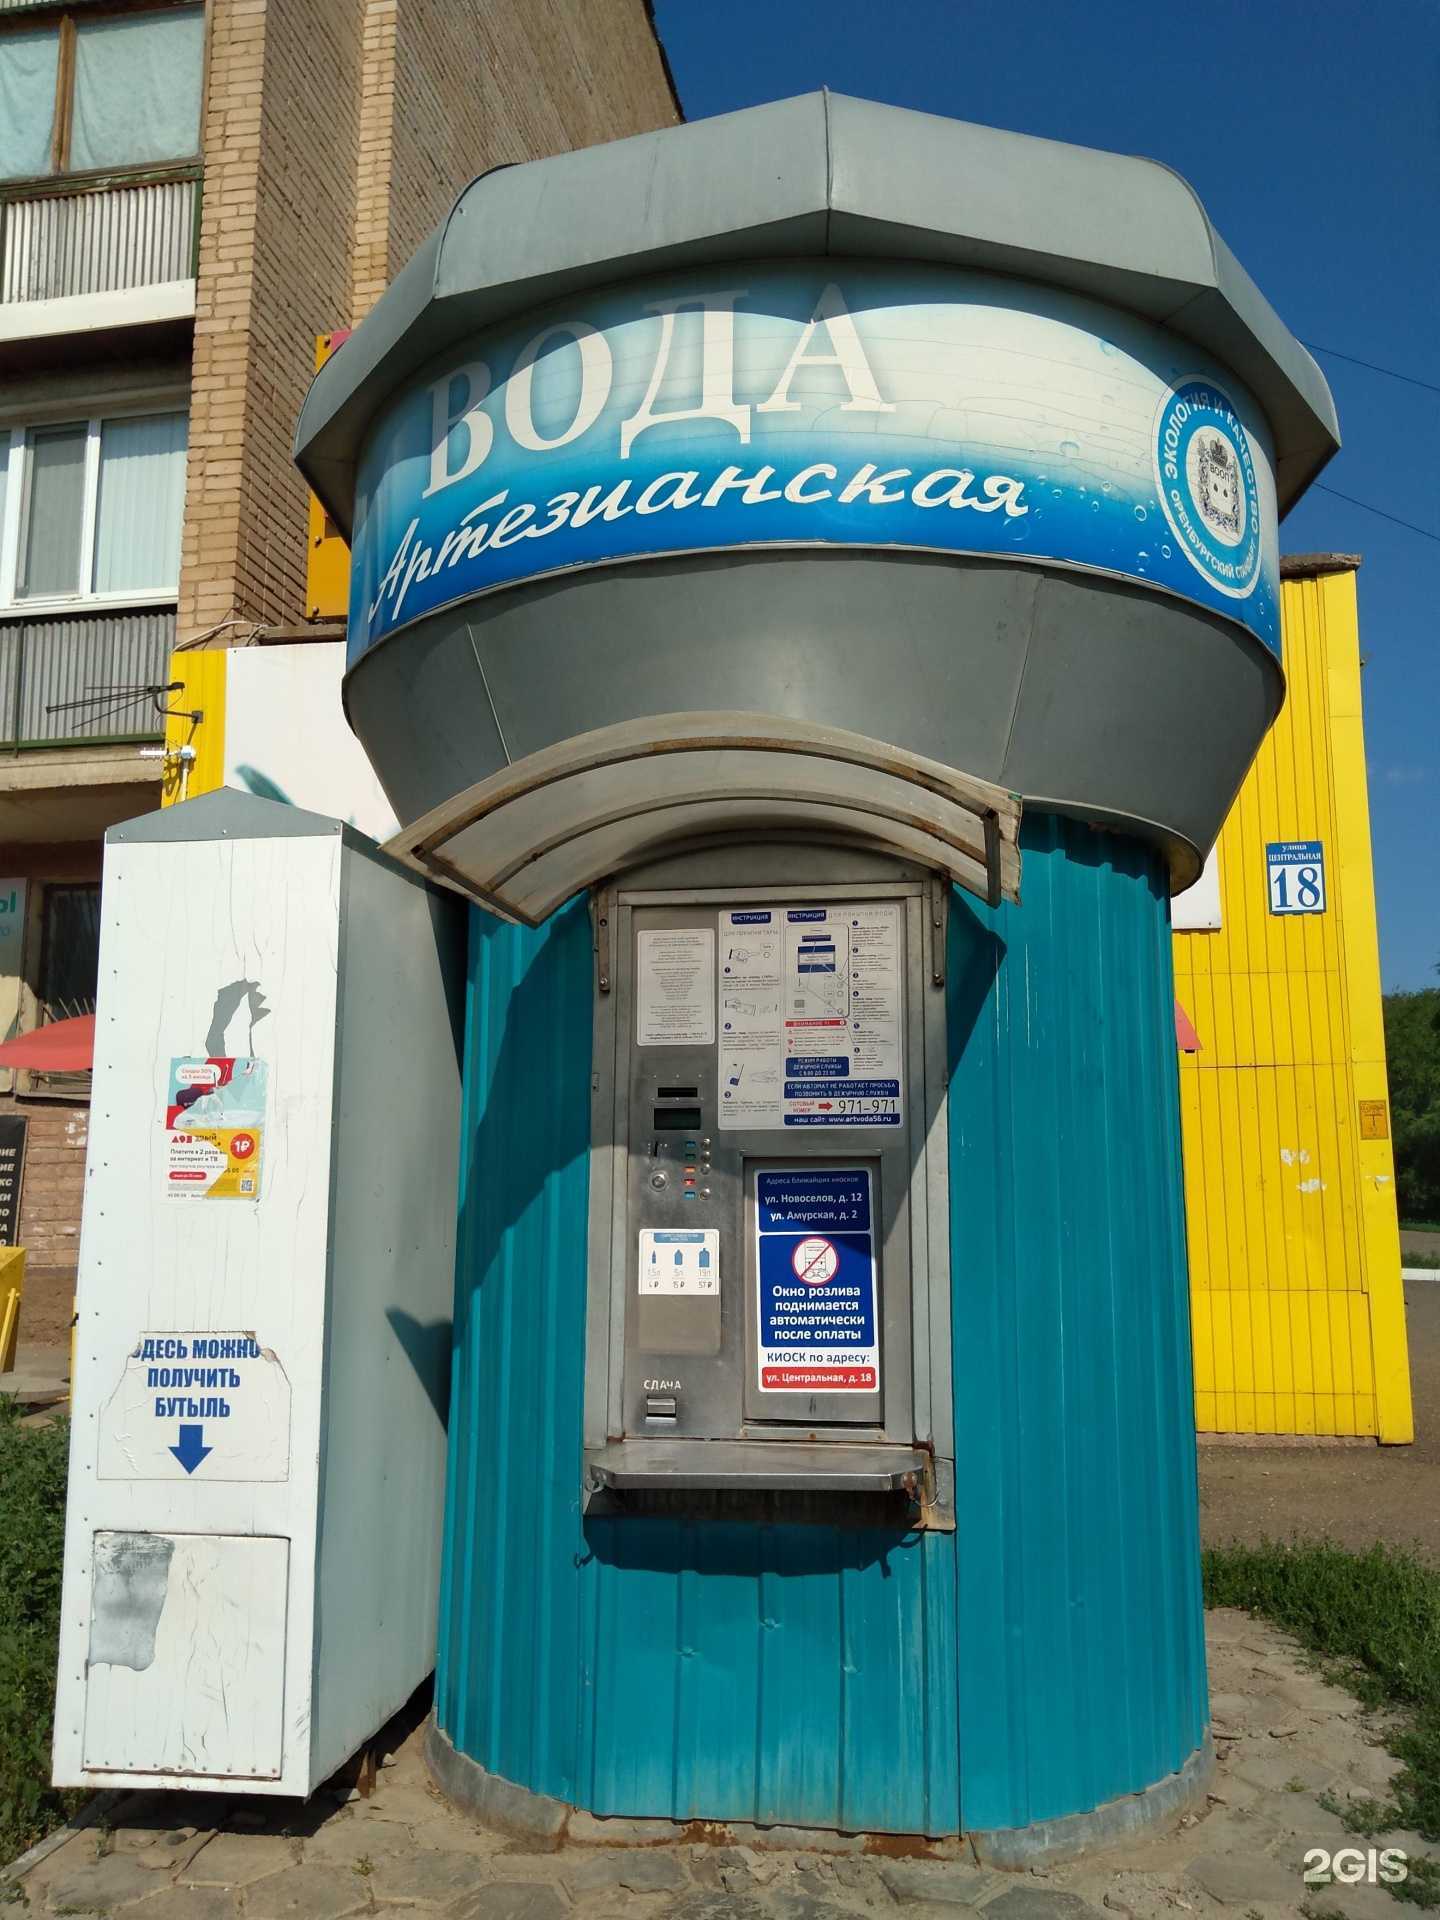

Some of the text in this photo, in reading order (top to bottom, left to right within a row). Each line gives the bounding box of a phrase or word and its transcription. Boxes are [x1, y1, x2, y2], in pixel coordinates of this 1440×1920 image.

[421, 282, 896, 499] ВОДА
[1164, 391, 1259, 534] ЭКОЛОГИЯ И КАЧЕСТВО
[1209, 462, 1231, 485] ВООП
[1171, 489, 1236, 578] ОРЕНБУРГСКИЙ
[368, 462, 1030, 621] Артезианская
[1282, 844, 1307, 853] улица
[1268, 852, 1321, 862] ЦЕНТРАЛЬНАЯ
[1273, 867, 1321, 908] 18
[787, 912, 825, 920] ИНСТРУКЦИЯ
[838, 1100, 895, 1114] 971-971
[765, 1193, 862, 1205] ул. Новоселов, д. 12
[770, 1210, 858, 1222] ул. Амурская, д. 2
[772, 1286, 861, 1299] Окно розлива
[775, 1301, 859, 1313] поднимается
[769, 1315, 865, 1325] автоматически
[774, 1330, 861, 1339] после оплаты
[767, 1352, 870, 1364] КИОСК по адресу:
[147, 1367, 241, 1388] ПОЛУЧИТЬ
[766, 1373, 872, 1384] ул. Центральная, д. 18
[643, 1379, 682, 1391] СДАЧА
[155, 1397, 231, 1417] БУТЫЛЬ
